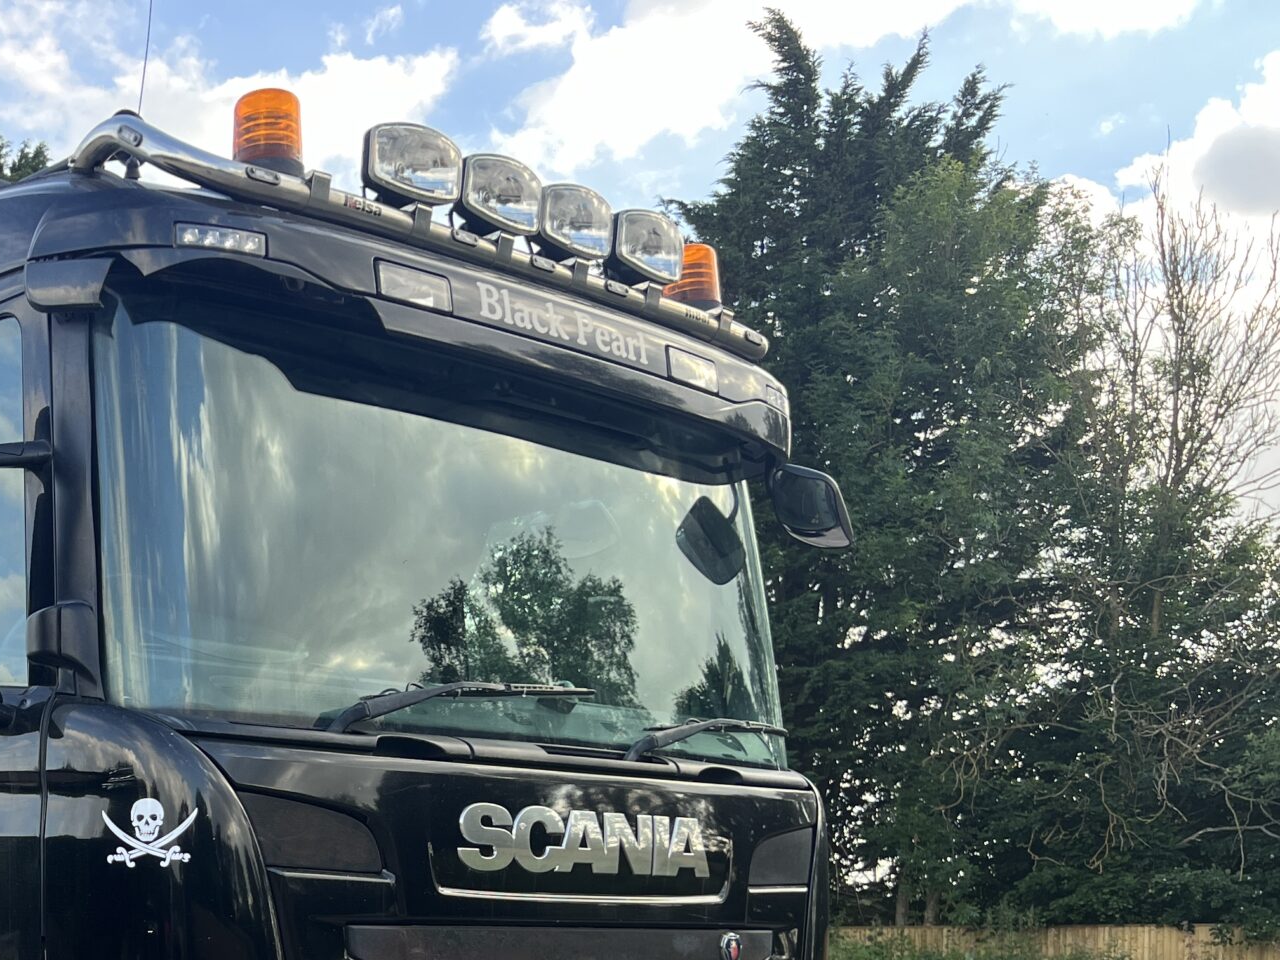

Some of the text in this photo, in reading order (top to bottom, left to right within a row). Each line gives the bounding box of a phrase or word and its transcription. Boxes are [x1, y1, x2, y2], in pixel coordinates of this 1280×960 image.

[476, 281, 649, 365] Black Pearl
[457, 802, 710, 878] SCANIA
